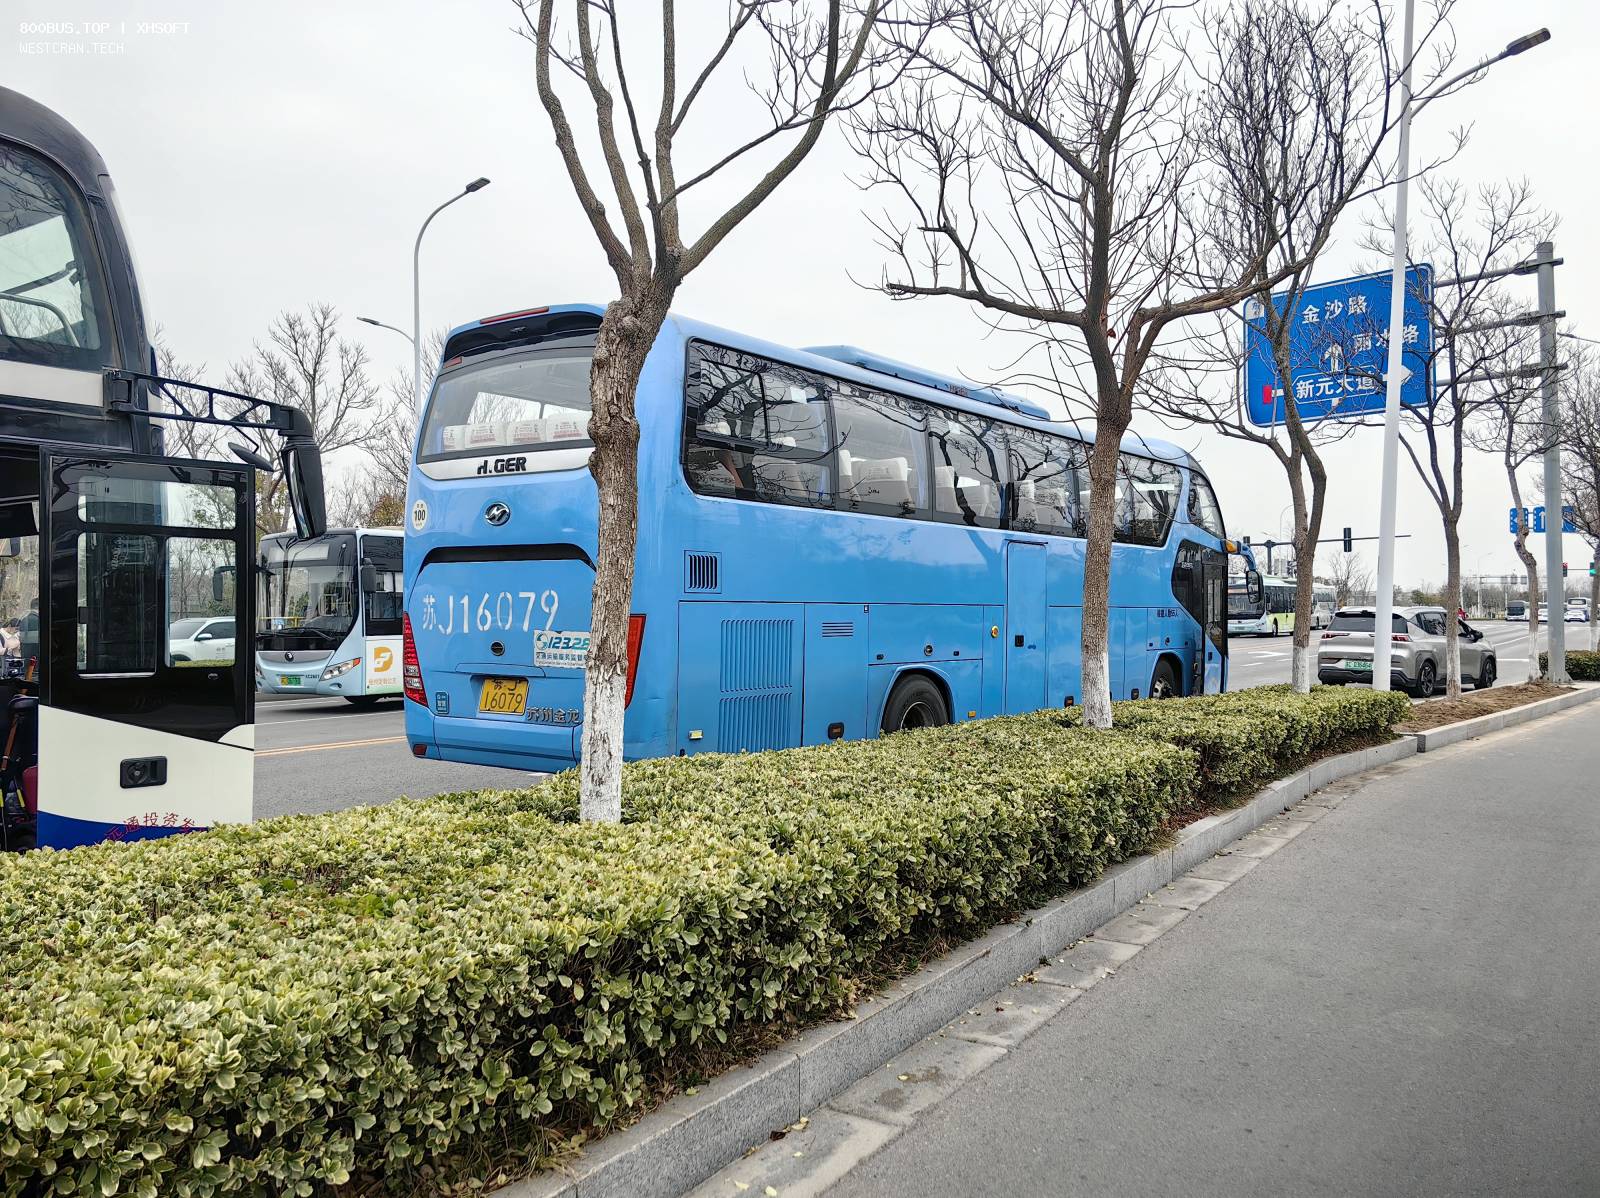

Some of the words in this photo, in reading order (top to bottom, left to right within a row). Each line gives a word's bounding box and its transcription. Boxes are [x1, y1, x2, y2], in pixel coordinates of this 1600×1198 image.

[1301, 295, 1368, 325] 金沙路
[1296, 370, 1376, 399] 新元大道
[414, 509, 426, 521] 100
[422, 589, 560, 635] 苏J16079
[484, 692, 523, 711] 16079
